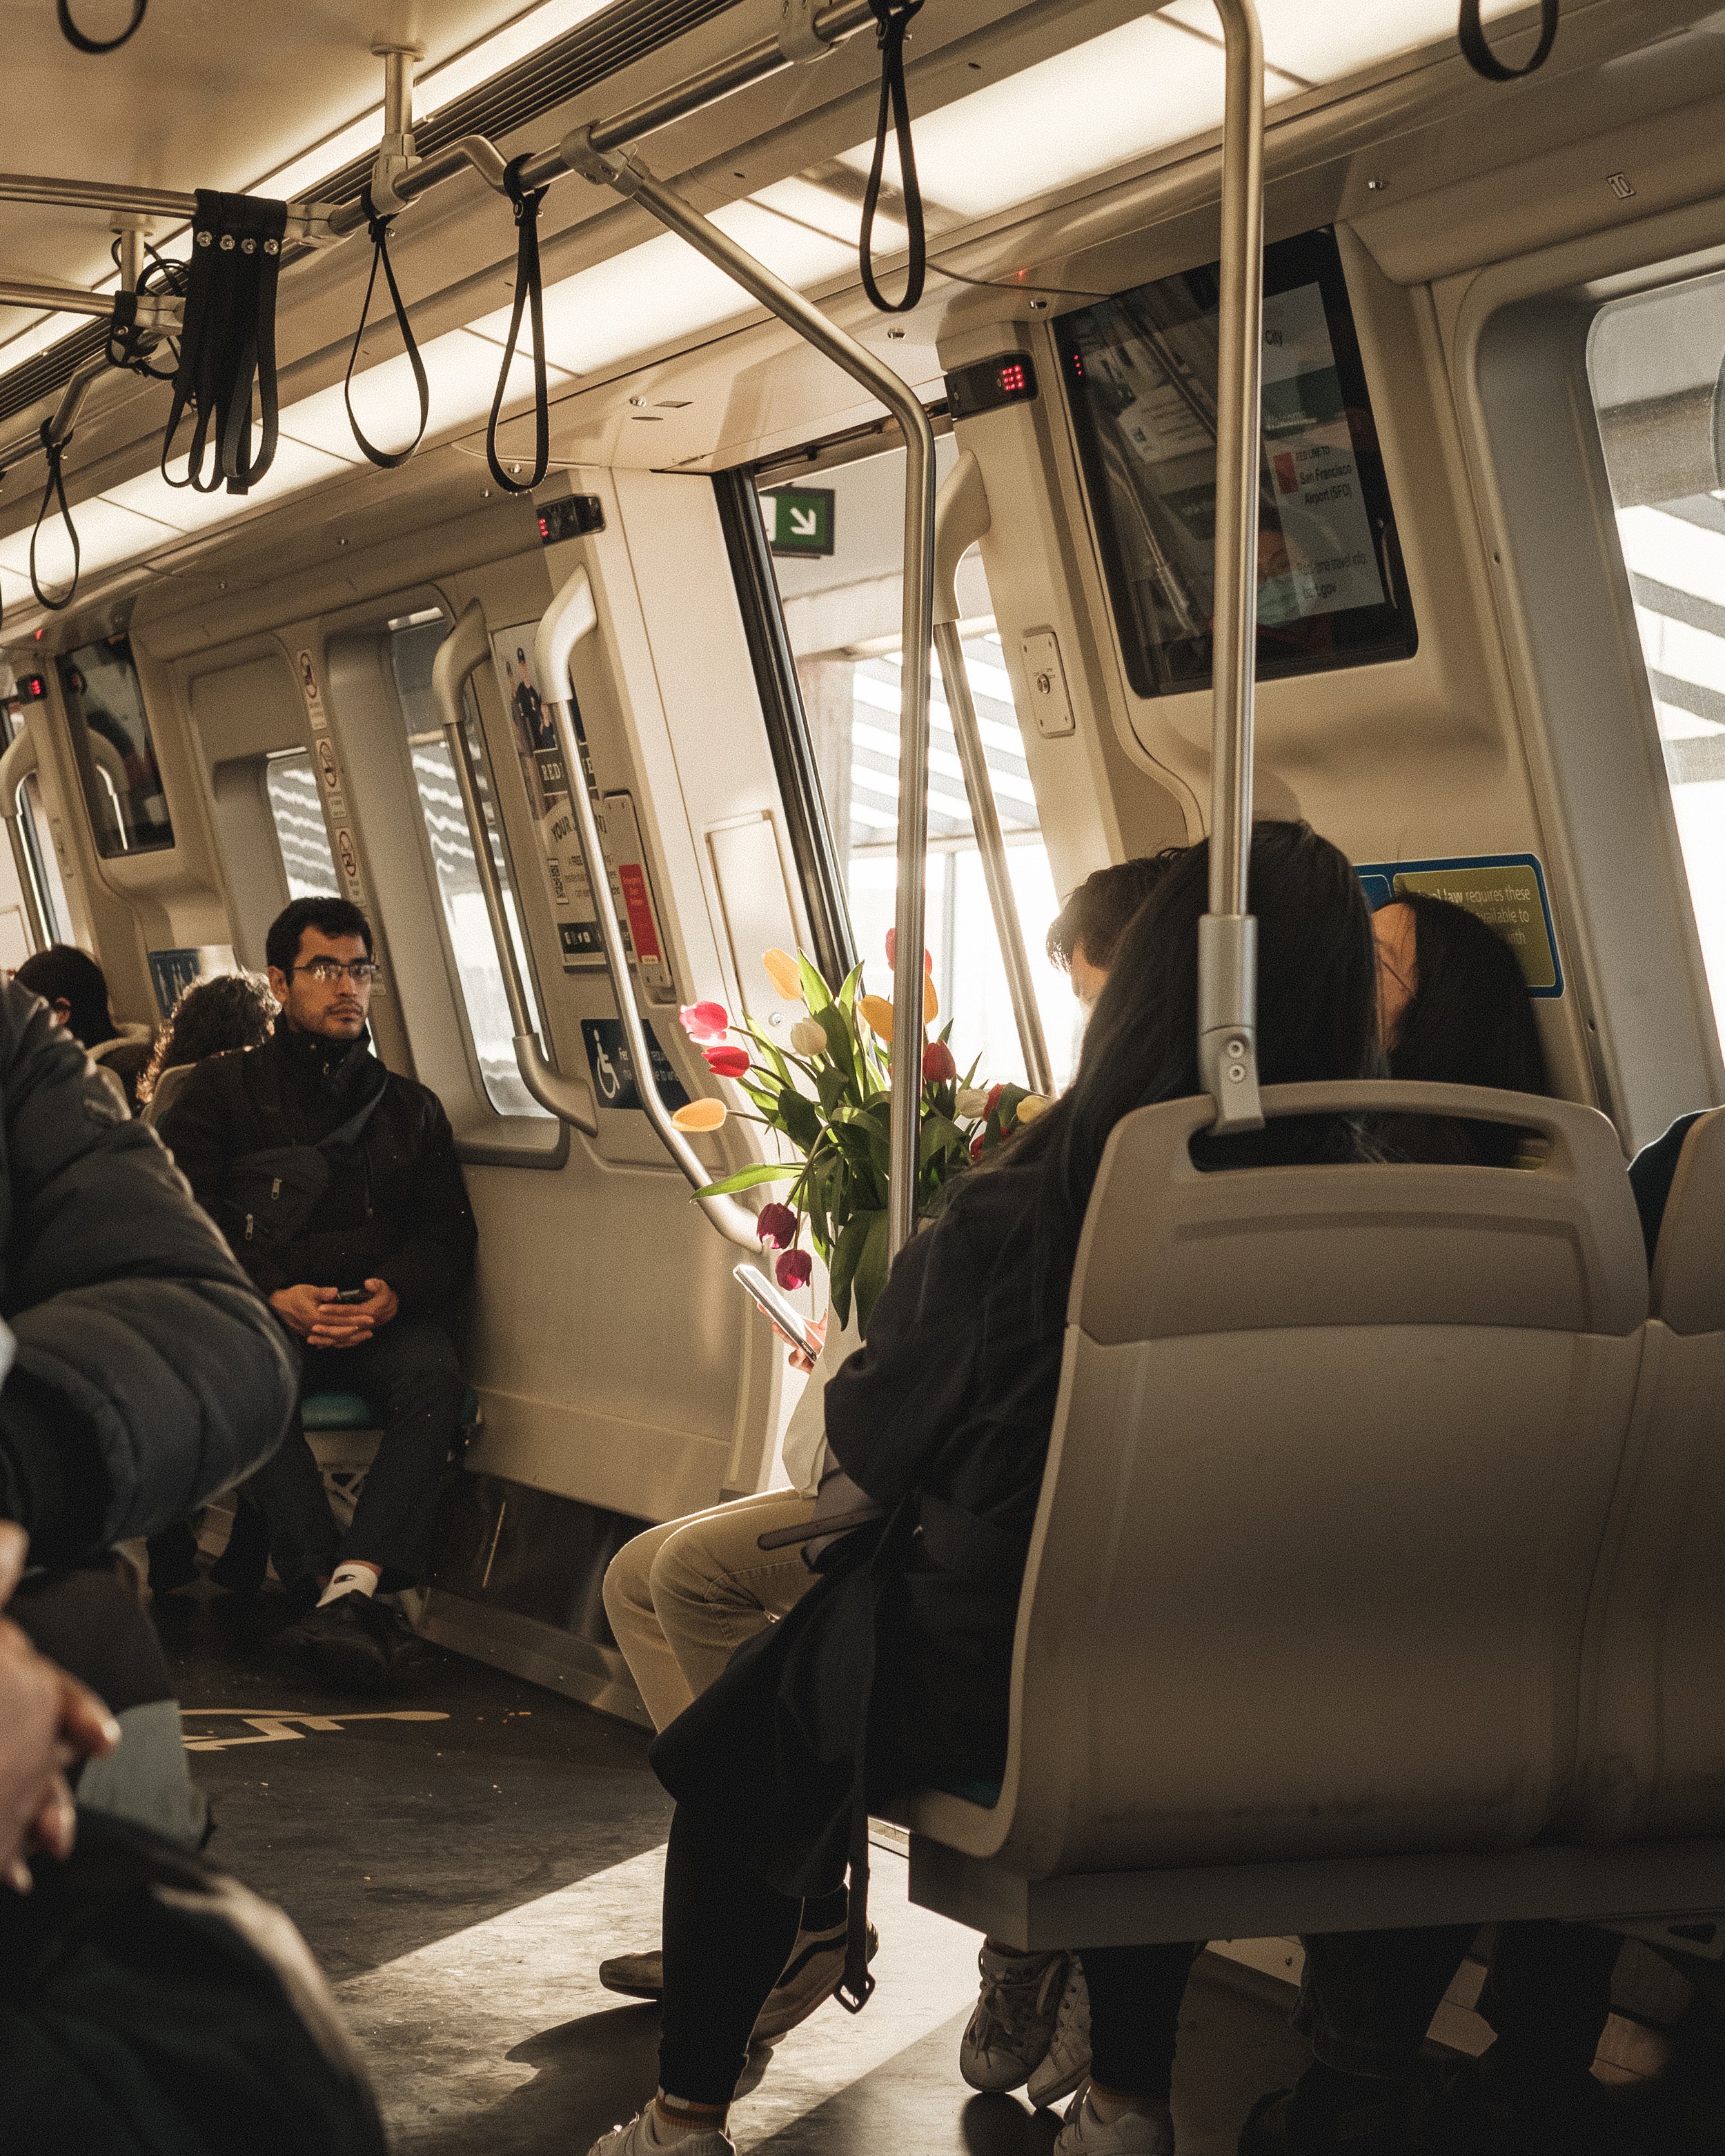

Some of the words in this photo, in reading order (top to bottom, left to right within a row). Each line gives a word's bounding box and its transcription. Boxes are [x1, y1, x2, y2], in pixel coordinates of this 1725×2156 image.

[1610, 175, 1633, 197] 10
[1299, 471, 1314, 485] San
[1315, 464, 1352, 481] Francisco
[1304, 489, 1330, 506] Airport
[1330, 482, 1352, 499] (SFO)
[1443, 888, 1463, 904] law
[1466, 889, 1504, 907] requires
[1505, 884, 1531, 902] these
[1518, 909, 1530, 923] to
